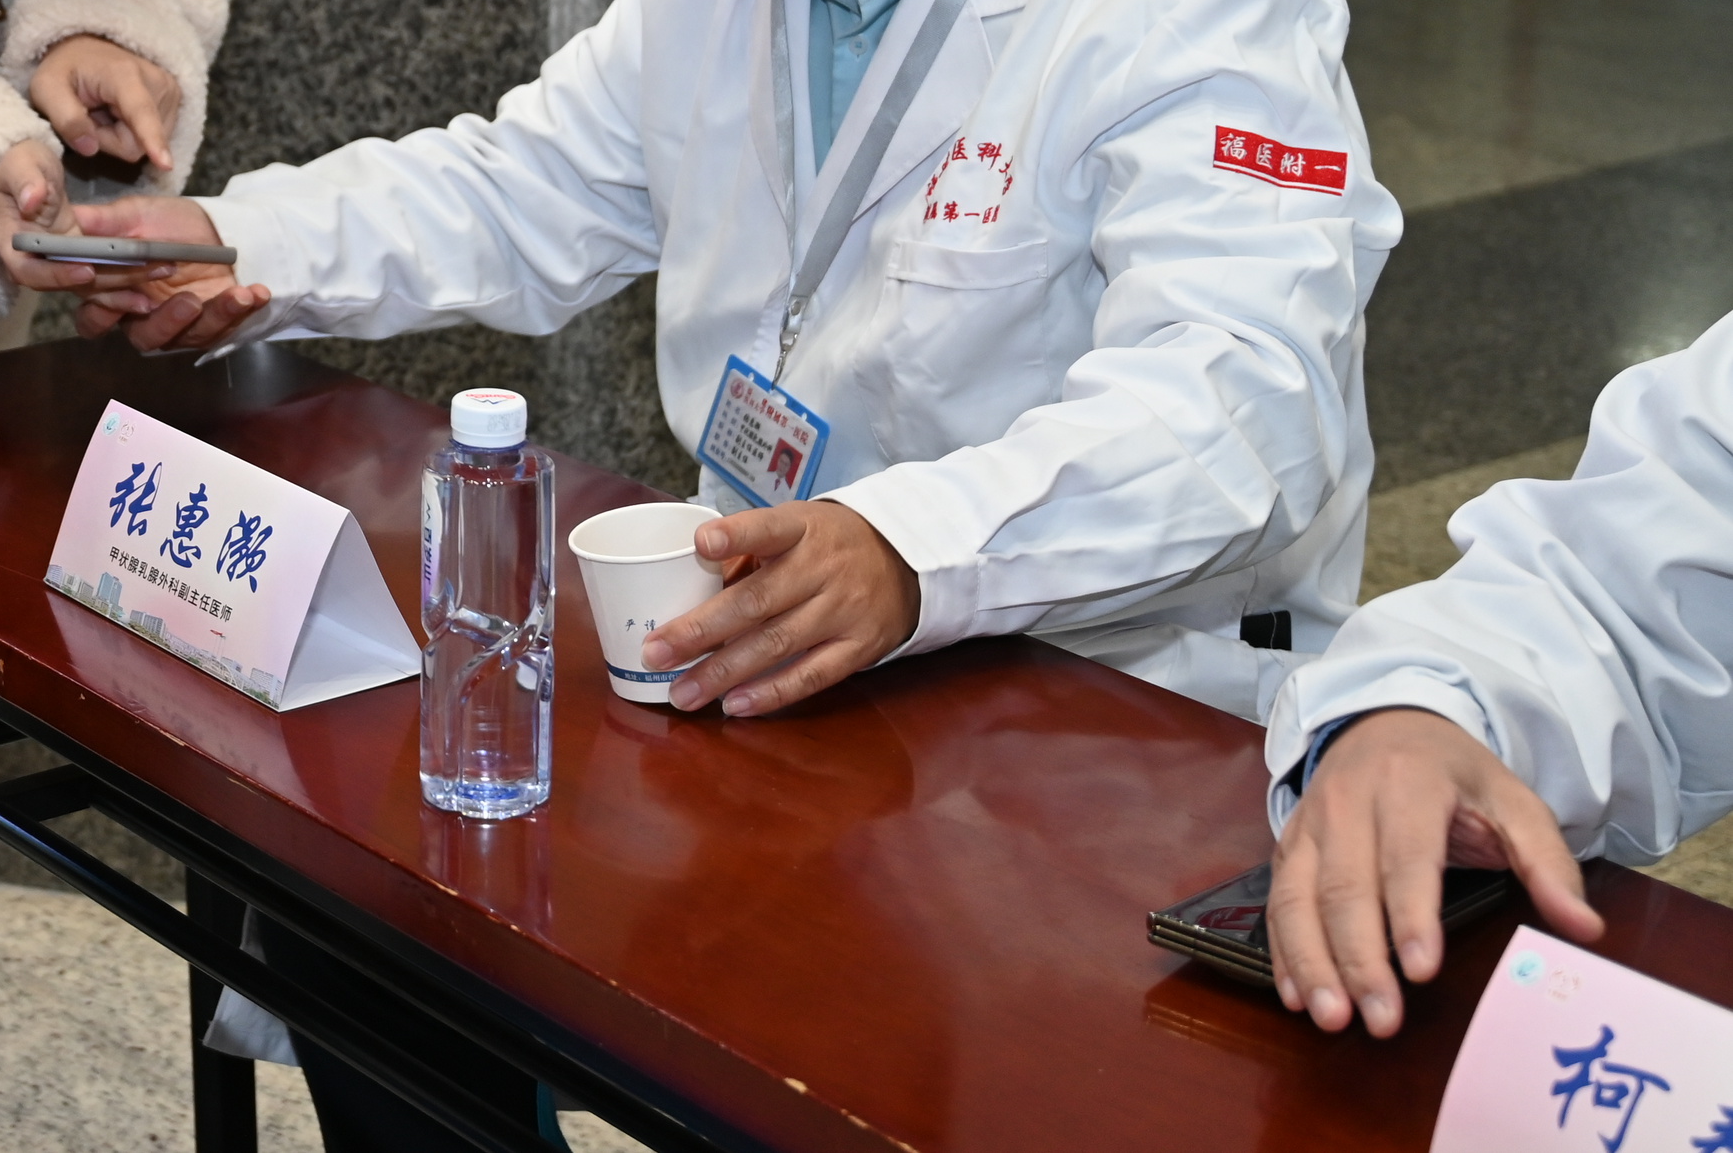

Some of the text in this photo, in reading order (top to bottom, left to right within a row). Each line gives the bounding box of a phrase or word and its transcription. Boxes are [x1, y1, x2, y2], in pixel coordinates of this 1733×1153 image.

[1220, 132, 1342, 177] 福医附一
[108, 545, 234, 624] 甲状腺乳腺外科副主任医师
[1550, 1022, 1733, 1153] 柯
